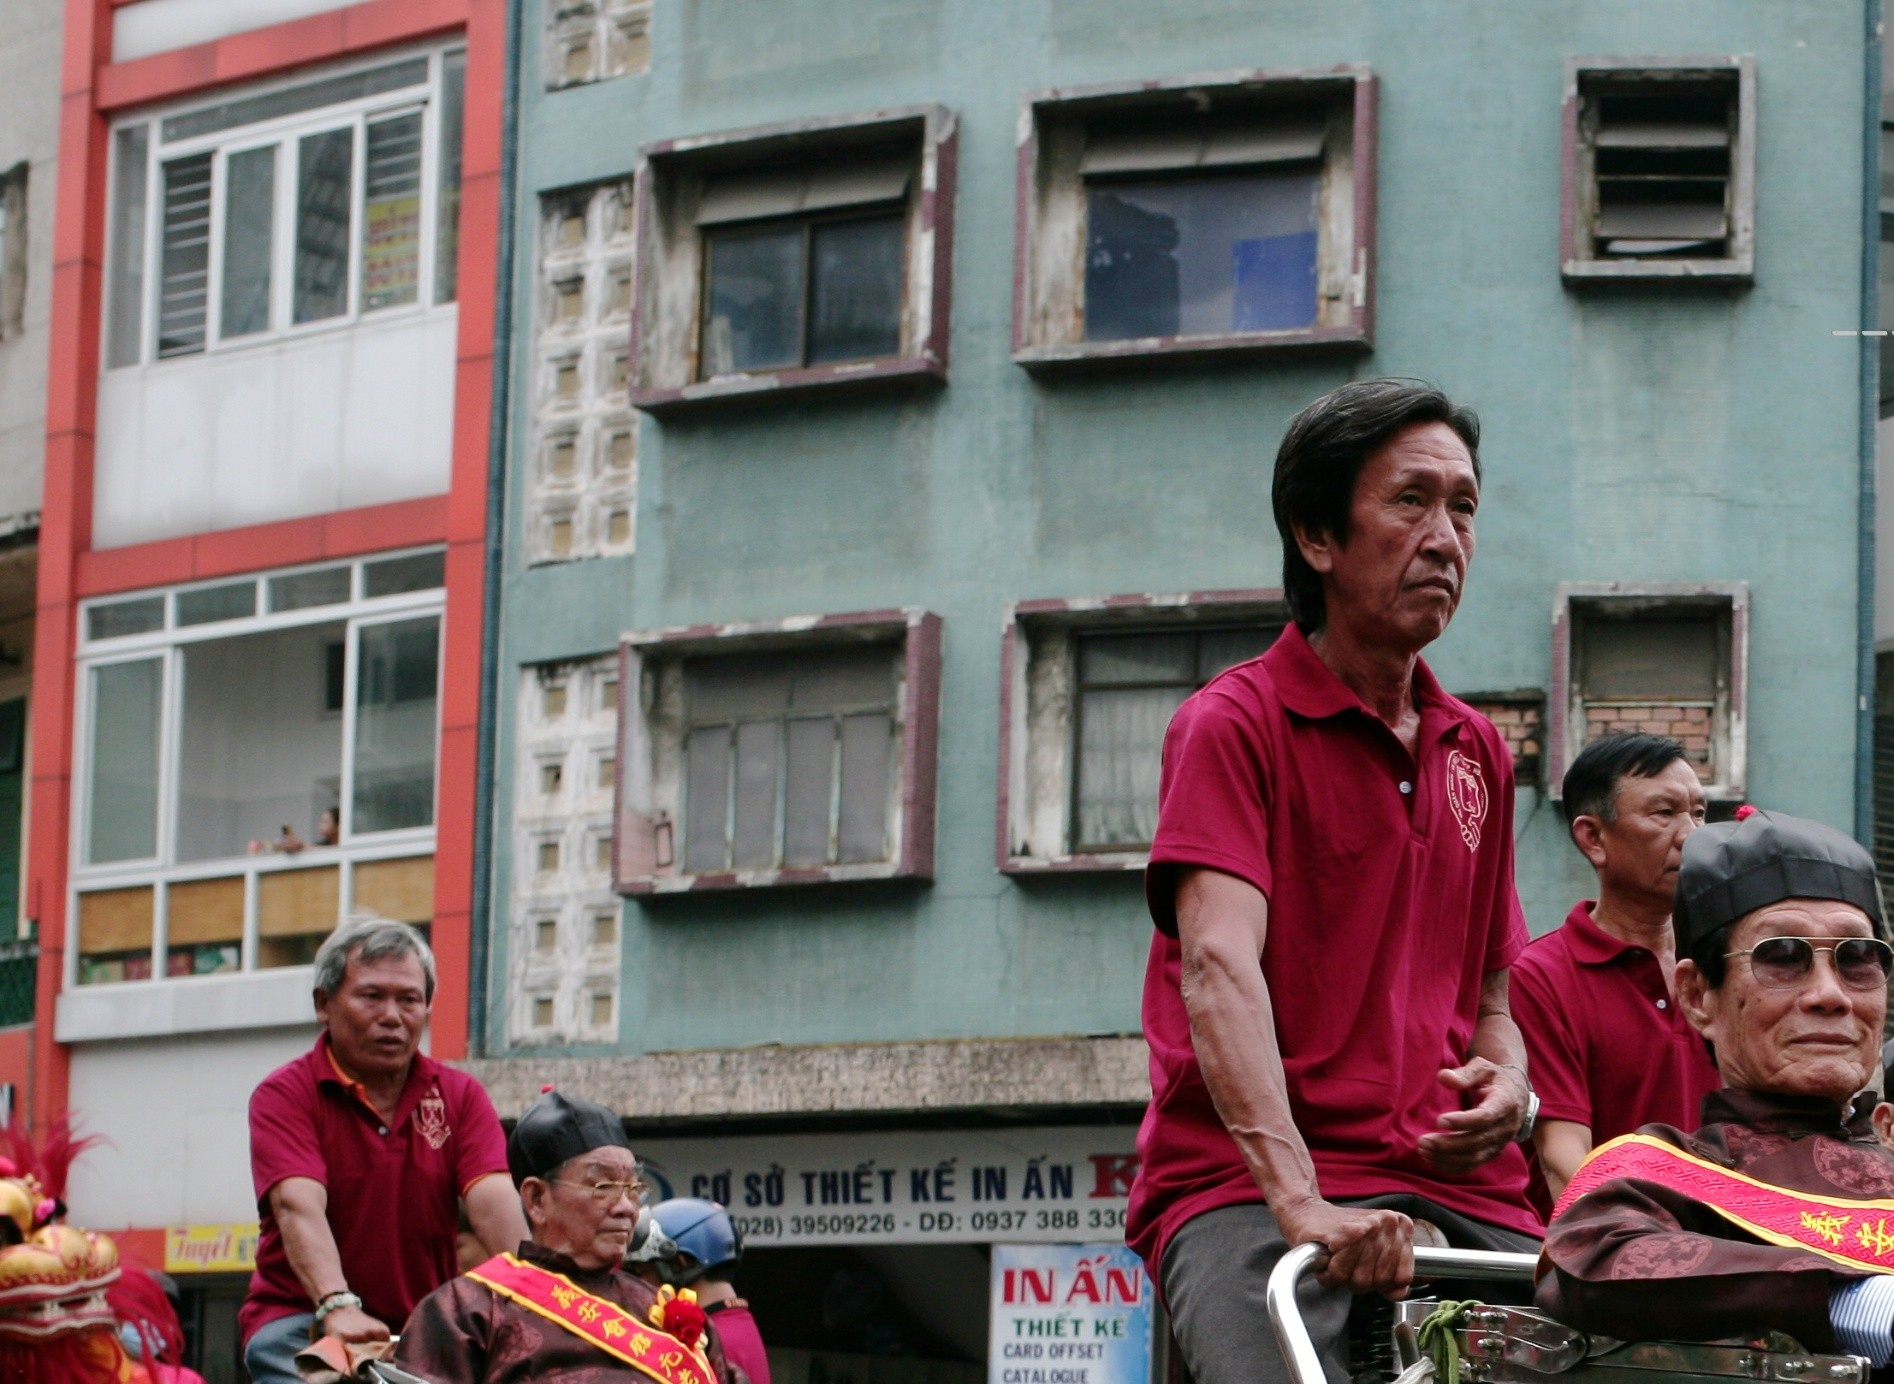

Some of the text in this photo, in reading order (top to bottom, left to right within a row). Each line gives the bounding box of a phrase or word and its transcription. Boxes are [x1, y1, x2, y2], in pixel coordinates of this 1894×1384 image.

[744, 1161, 786, 1207] SỞ
[799, 1159, 896, 1206] THIẾT
[910, 1156, 957, 1203] KẾ
[972, 1166, 1007, 1201] IN
[1022, 1154, 1074, 1201] ẤN
[790, 1213, 896, 1235] 39509226
[971, 1210, 1027, 1232] 0937
[1036, 1209, 1080, 1230] 388
[1003, 1253, 1141, 1304] IN ẤN
[1013, 1310, 1126, 1338] THIẾT KẾ
[1003, 1342, 1105, 1360] CARD OFFSET
